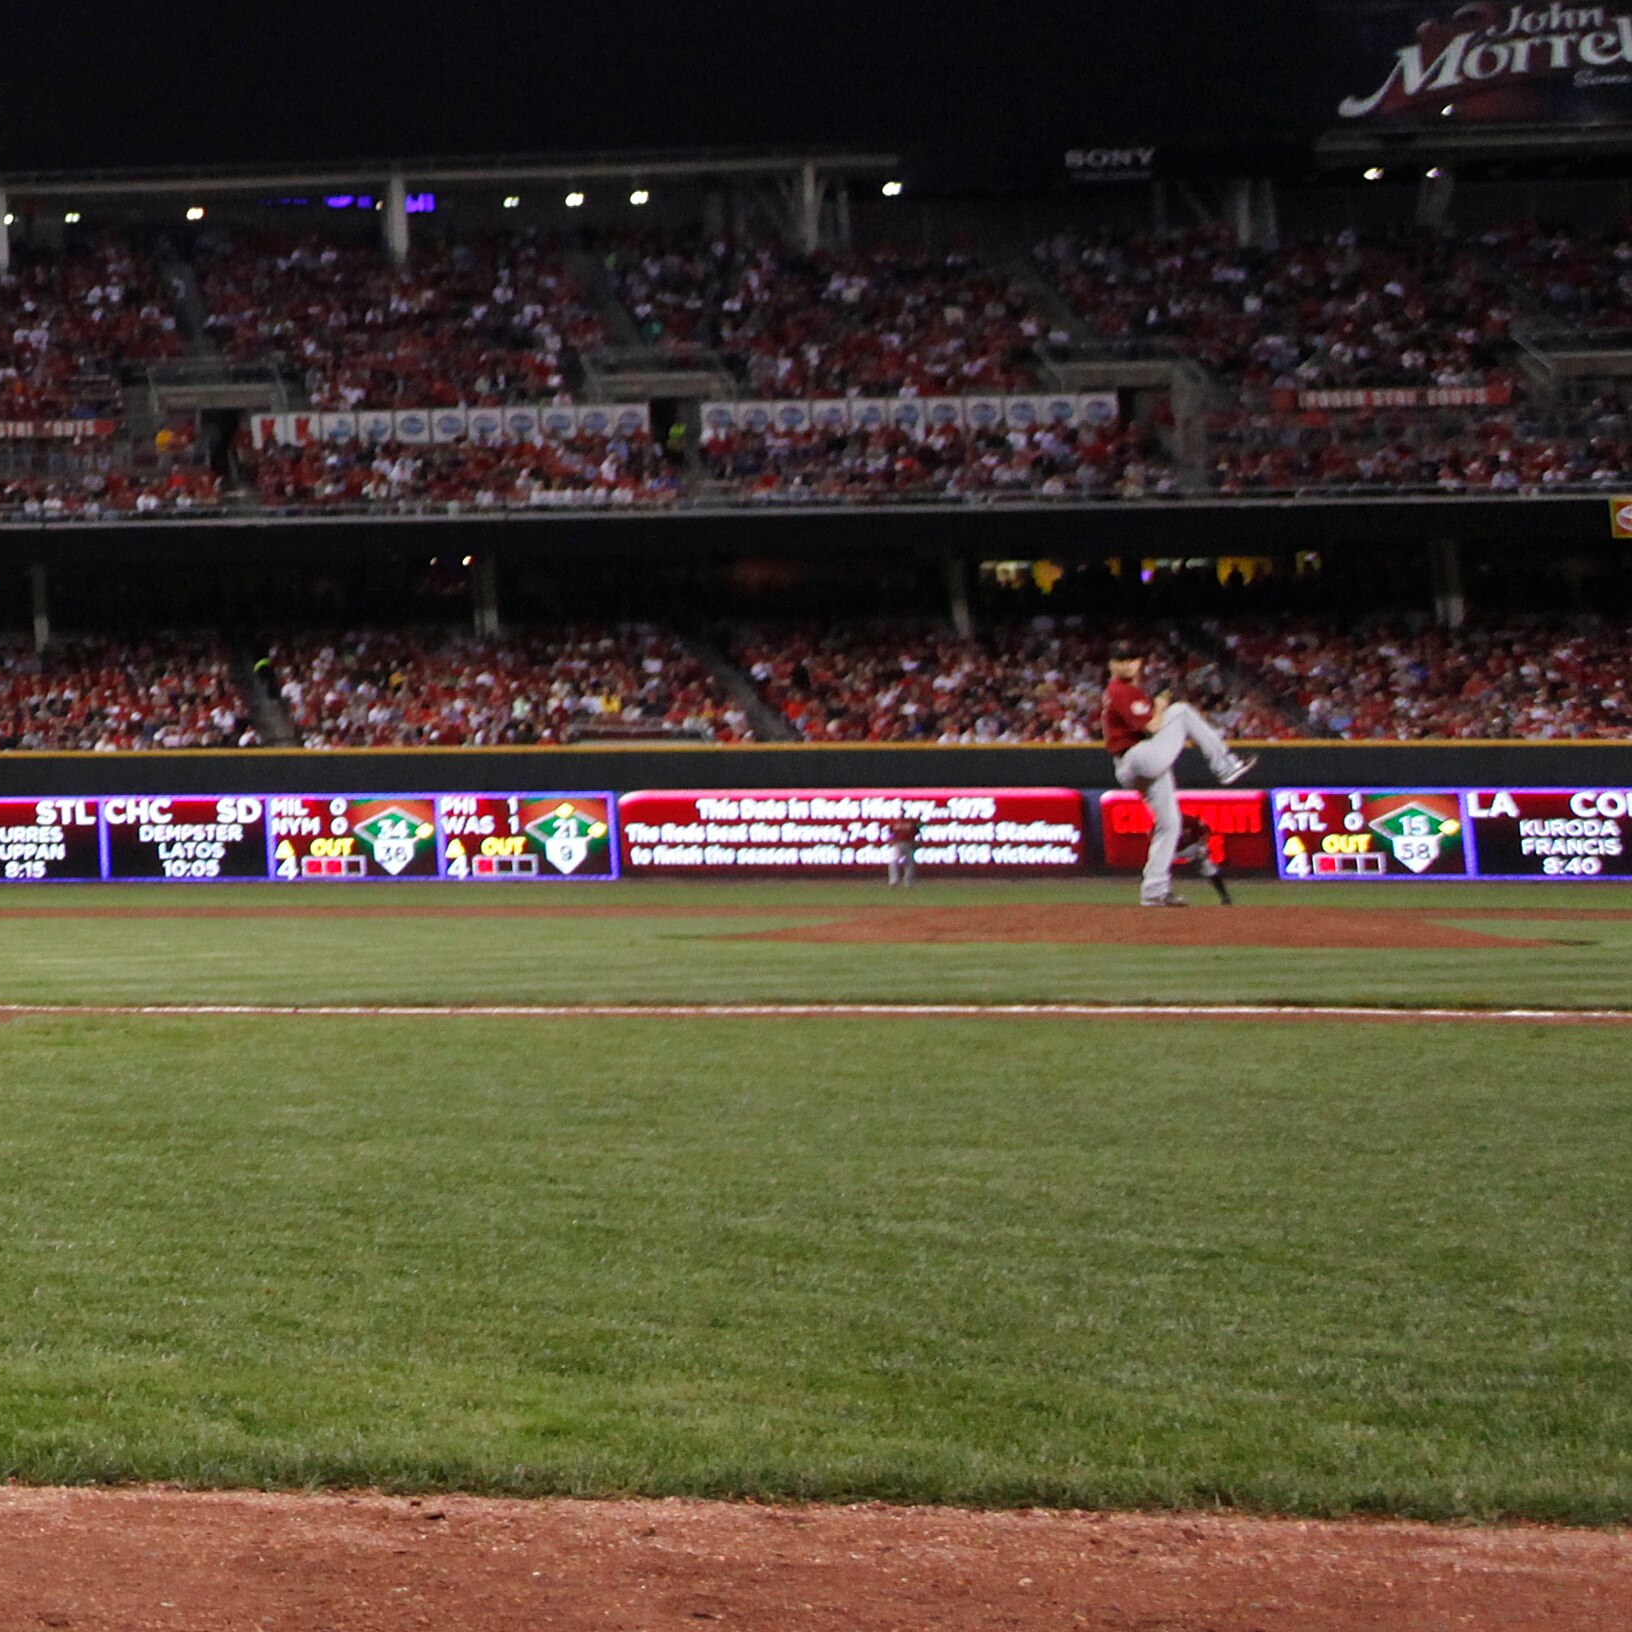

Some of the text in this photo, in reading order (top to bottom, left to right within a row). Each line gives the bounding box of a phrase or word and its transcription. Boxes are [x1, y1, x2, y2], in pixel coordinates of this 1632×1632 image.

[1486, 2, 1604, 36] John
[1064, 148, 1156, 169] SONY
[104, 798, 262, 824] CHC SD
[271, 798, 347, 816] MIL 0
[440, 796, 518, 815] PHI 1
[695, 798, 739, 819] This
[740, 798, 787, 819] Date
[788, 797, 809, 819] in
[810, 797, 860, 819] Reds
[1276, 792, 1362, 811] FLA 1
[1466, 791, 1632, 818] LA CO
[36, 801, 96, 825] STL
[1278, 811, 1365, 832] ATL 0
[139, 824, 243, 842] DEMPSTER
[272, 817, 349, 835] NYM 0
[377, 819, 409, 839] 34
[441, 816, 519, 834] WAS 1
[552, 819, 579, 839] 21
[625, 823, 660, 843] The
[661, 823, 706, 843] Reds
[749, 822, 781, 843] the
[1399, 814, 1430, 836] 15
[1519, 819, 1621, 836] KURODA
[158, 842, 225, 860] LATOS
[310, 838, 355, 856] OUT
[481, 837, 526, 855] OUT
[1321, 833, 1372, 853] OUT
[1402, 843, 1431, 860] 58
[1521, 838, 1623, 855] FRANCIS
[559, 845, 571, 862] 9
[630, 845, 653, 865] to
[704, 844, 736, 865] the
[736, 847, 799, 865] season
[799, 844, 841, 865] with
[5, 861, 46, 878] 8:15
[163, 860, 220, 877] 10:05
[276, 856, 299, 879] 4
[447, 856, 469, 879] 4
[1286, 853, 1311, 878] 4
[1542, 857, 1602, 875] 8:40
